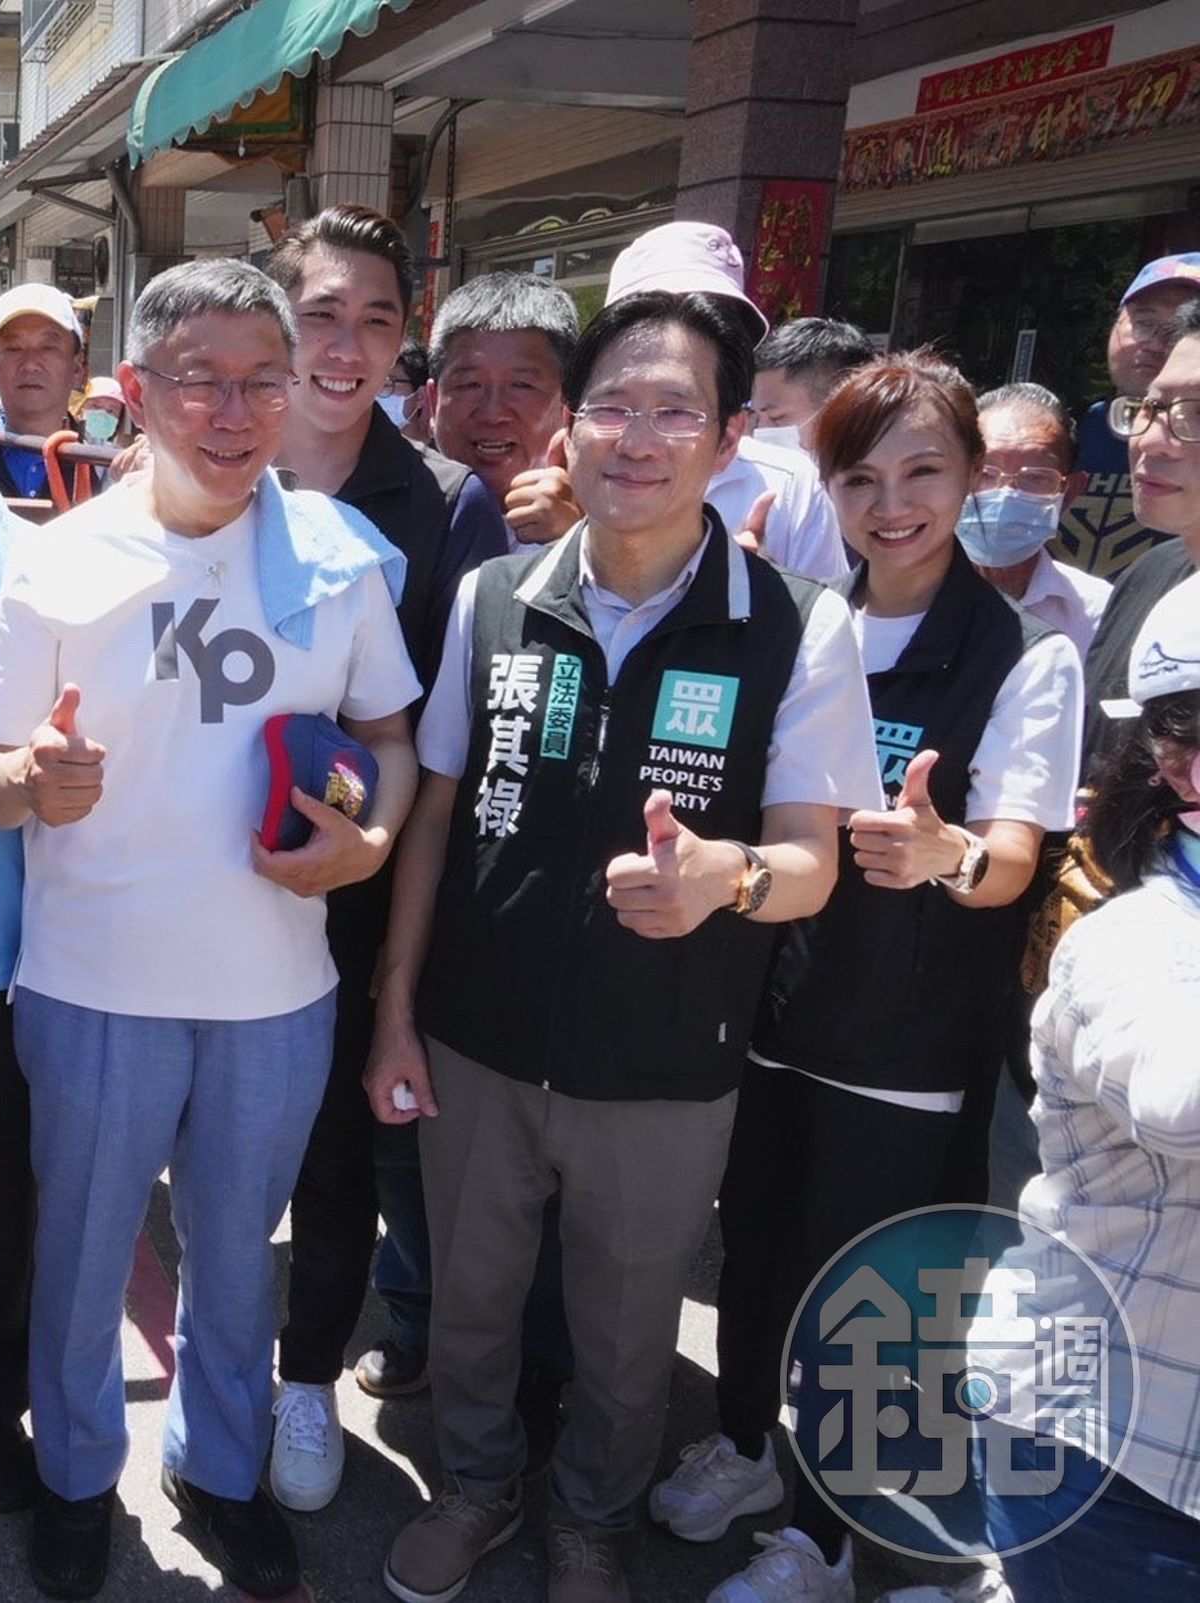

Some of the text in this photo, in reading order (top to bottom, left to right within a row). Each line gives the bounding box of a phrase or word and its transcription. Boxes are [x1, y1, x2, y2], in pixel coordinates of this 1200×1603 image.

[151, 598, 275, 724] Kp
[473, 653, 544, 838] 張其祿
[540, 656, 581, 758] 立法委員
[665, 679, 724, 737] 眾
[638, 765, 723, 792] PEOPLE'S
[648, 744, 726, 771] TAIWAN
